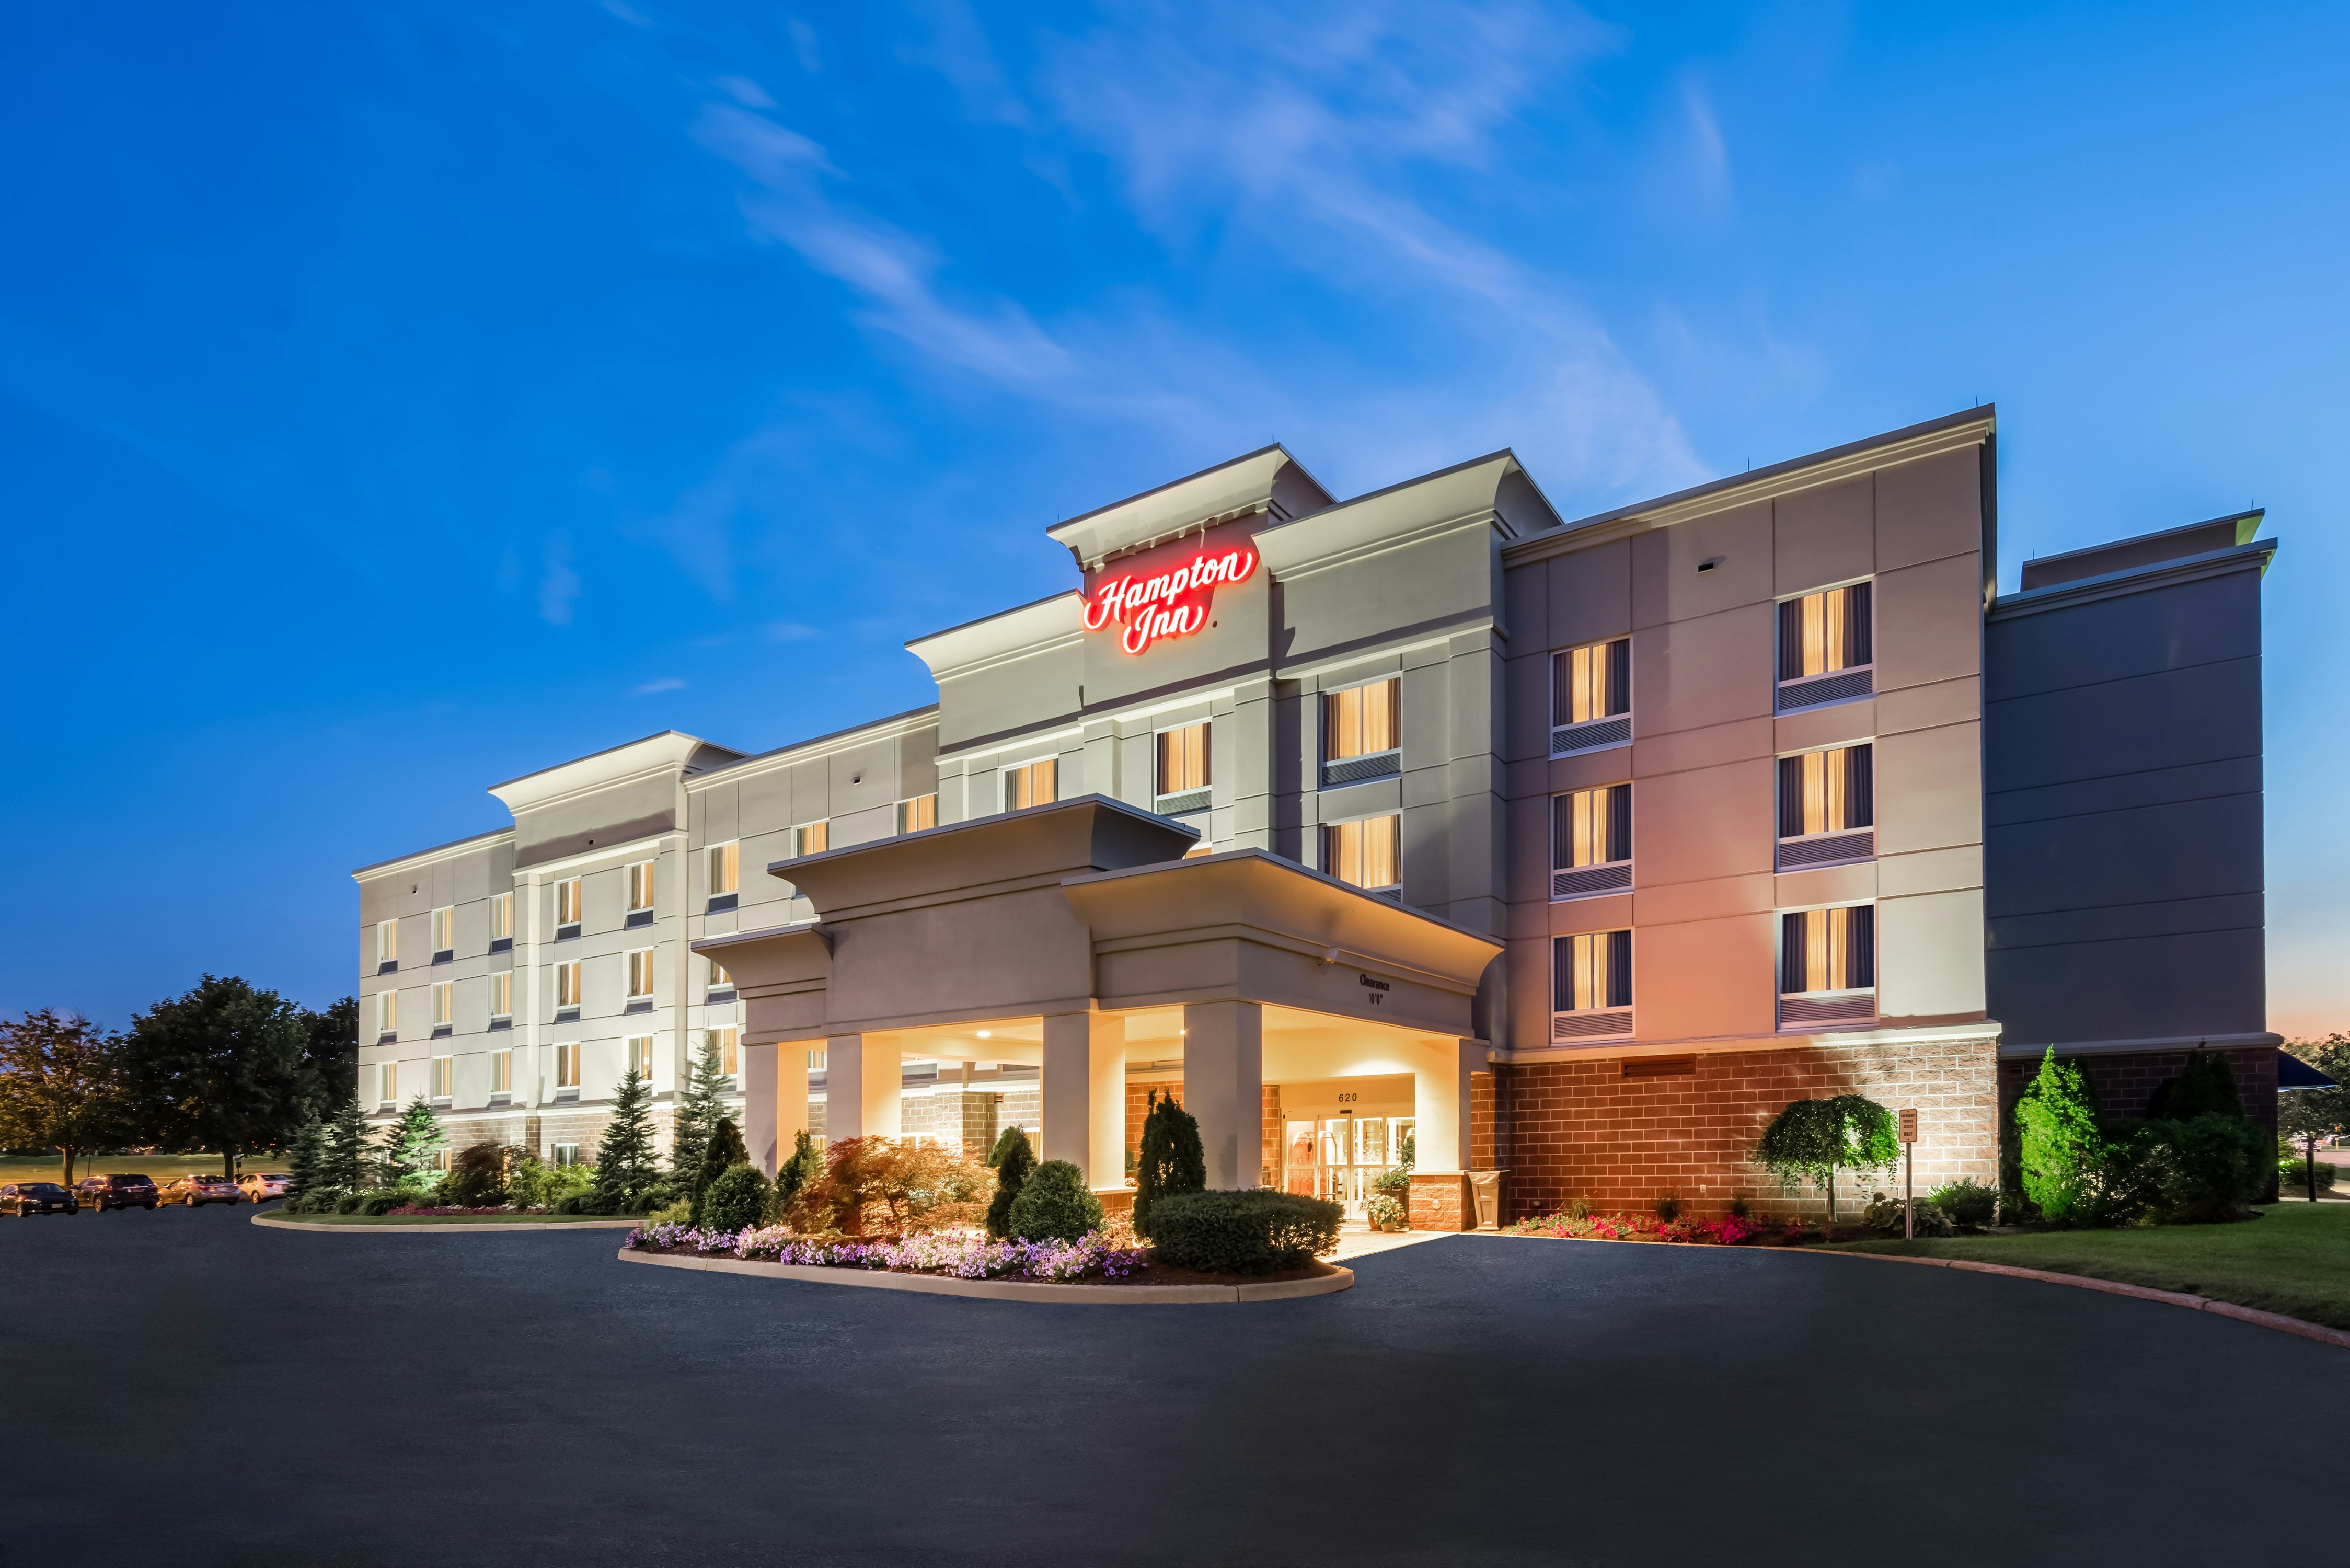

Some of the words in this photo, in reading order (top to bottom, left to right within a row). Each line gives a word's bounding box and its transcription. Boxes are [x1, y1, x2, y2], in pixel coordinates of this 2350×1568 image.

[1084, 552, 1252, 629] Hampton
[1123, 604, 1203, 653] Inn
[1360, 974, 1390, 991] Clearance
[1339, 1093, 1357, 1102] 620
